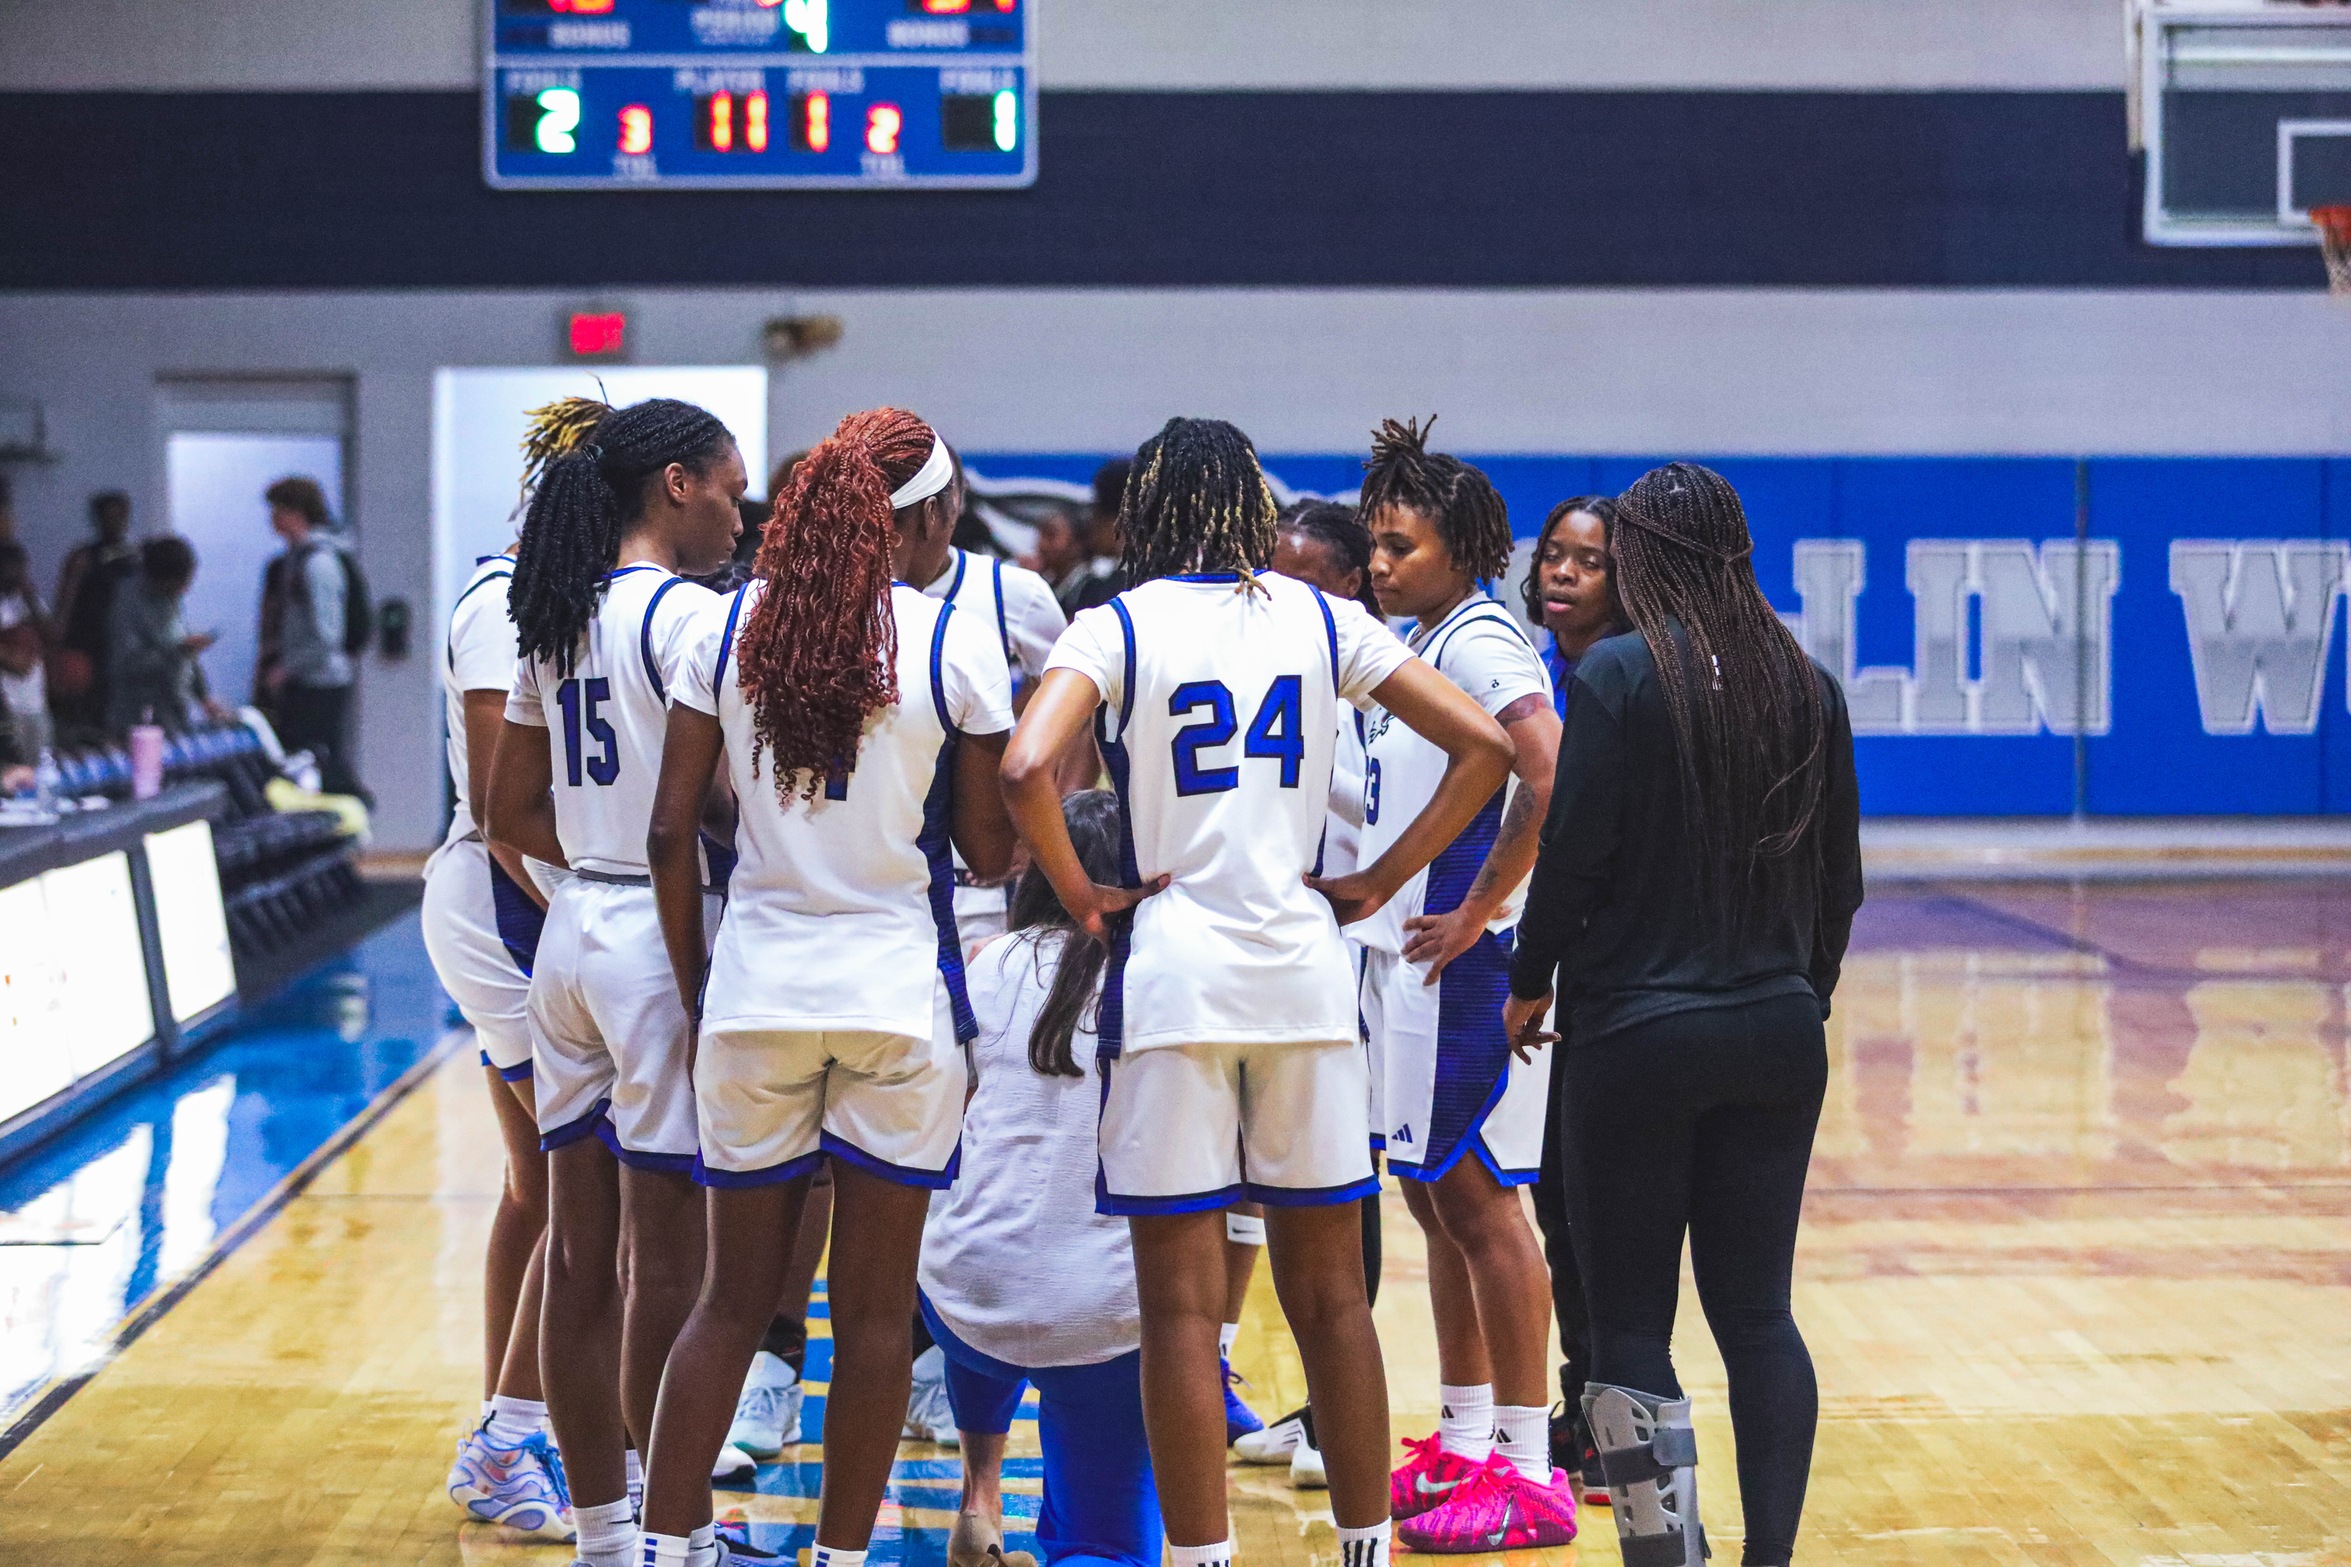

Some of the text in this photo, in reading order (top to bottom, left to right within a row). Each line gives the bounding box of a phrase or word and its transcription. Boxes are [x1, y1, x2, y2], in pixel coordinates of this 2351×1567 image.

[537, 87, 581, 154] 2
[617, 104, 653, 154] 3
[994, 89, 1016, 153] 1
[1780, 538, 2121, 736] LIN
[2168, 538, 2351, 736] W
[556, 676, 620, 787] 15
[1168, 674, 1305, 797] 24
[1364, 755, 1381, 827] 3
